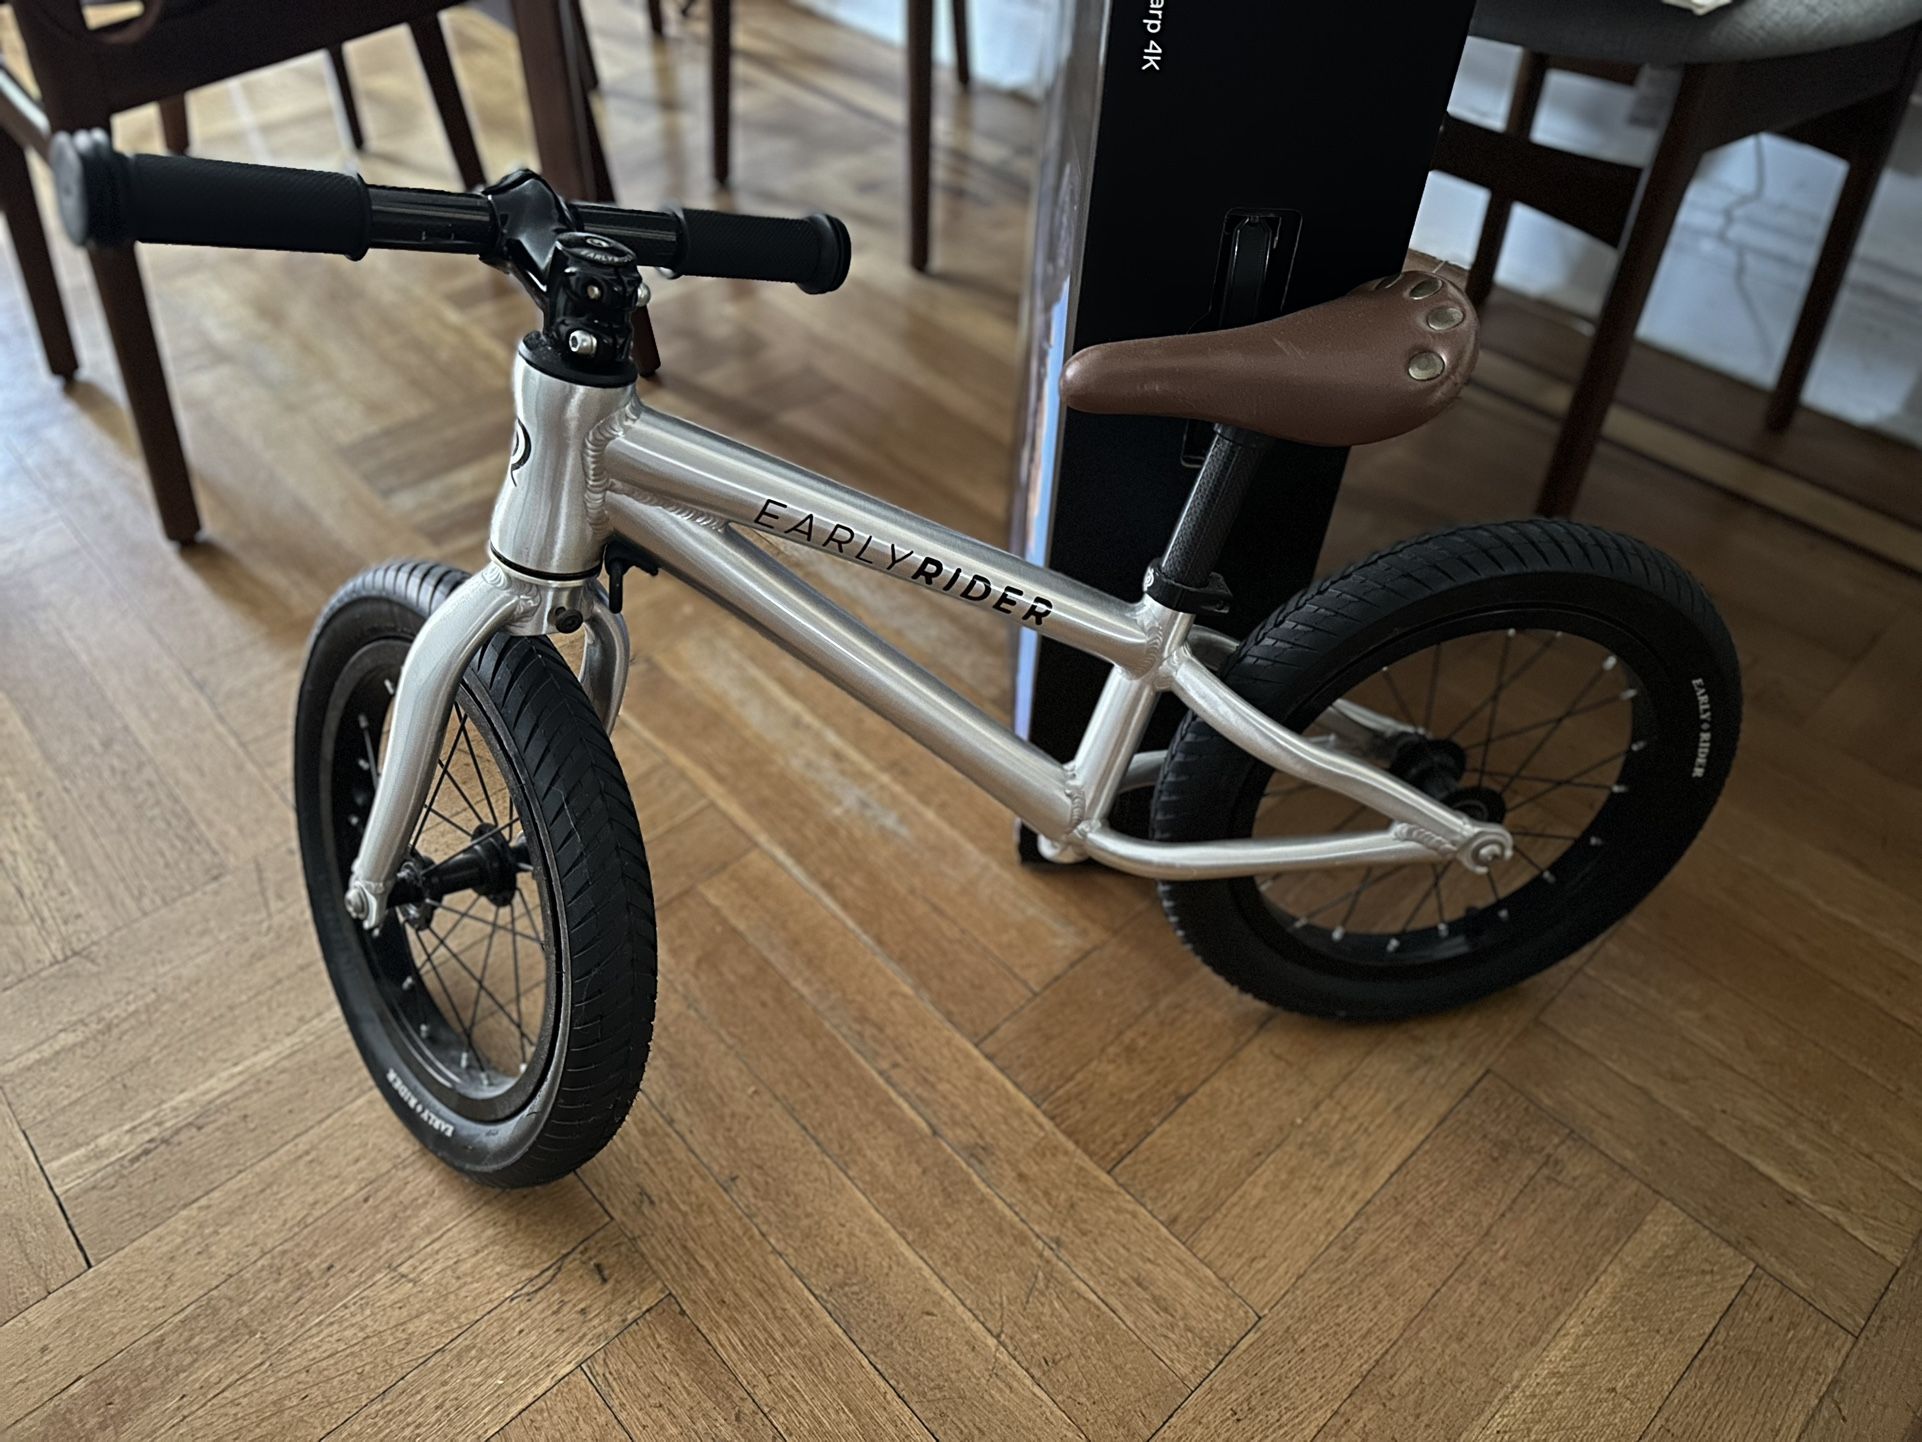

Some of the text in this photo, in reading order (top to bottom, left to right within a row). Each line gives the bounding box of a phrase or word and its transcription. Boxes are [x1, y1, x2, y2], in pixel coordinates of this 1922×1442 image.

[1141, 40, 1163, 71] 4K
[1691, 678, 1712, 778] EARLY RIDER
[420, 1108, 455, 1138] EARLY
